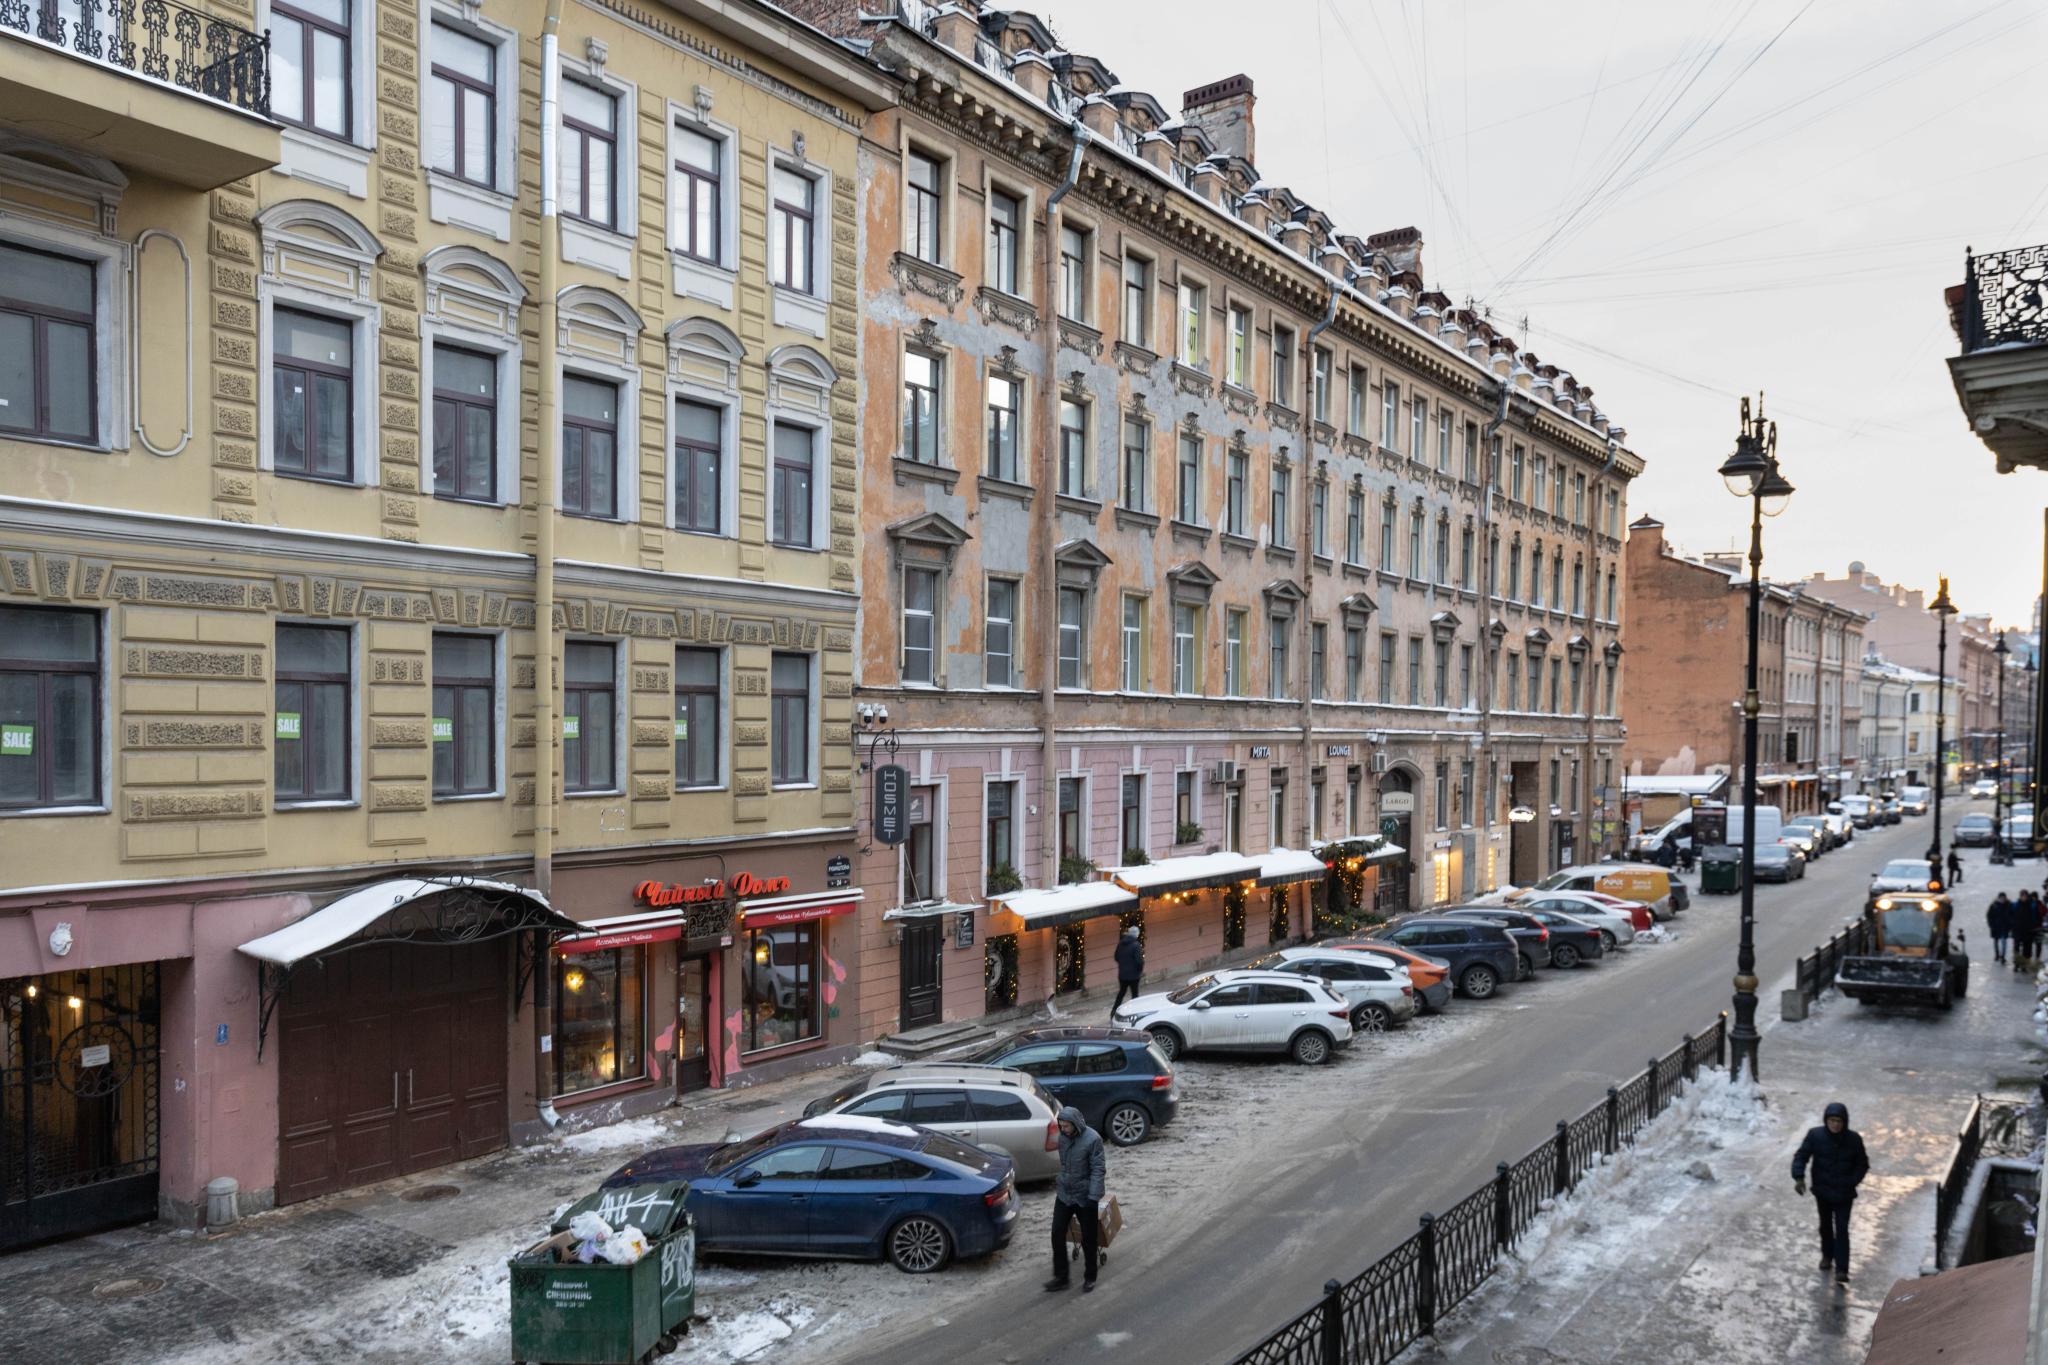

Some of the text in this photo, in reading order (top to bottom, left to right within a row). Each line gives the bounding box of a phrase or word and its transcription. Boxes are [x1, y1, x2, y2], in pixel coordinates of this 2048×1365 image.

[277, 719, 300, 733] SALE
[433, 723, 452, 736] SALE
[2, 732, 31, 748] SALE
[1252, 745, 1351, 758] МЯТА LOUNGE
[884, 770, 896, 839] KOSMET
[634, 871, 791, 907] Чайный Домъ
